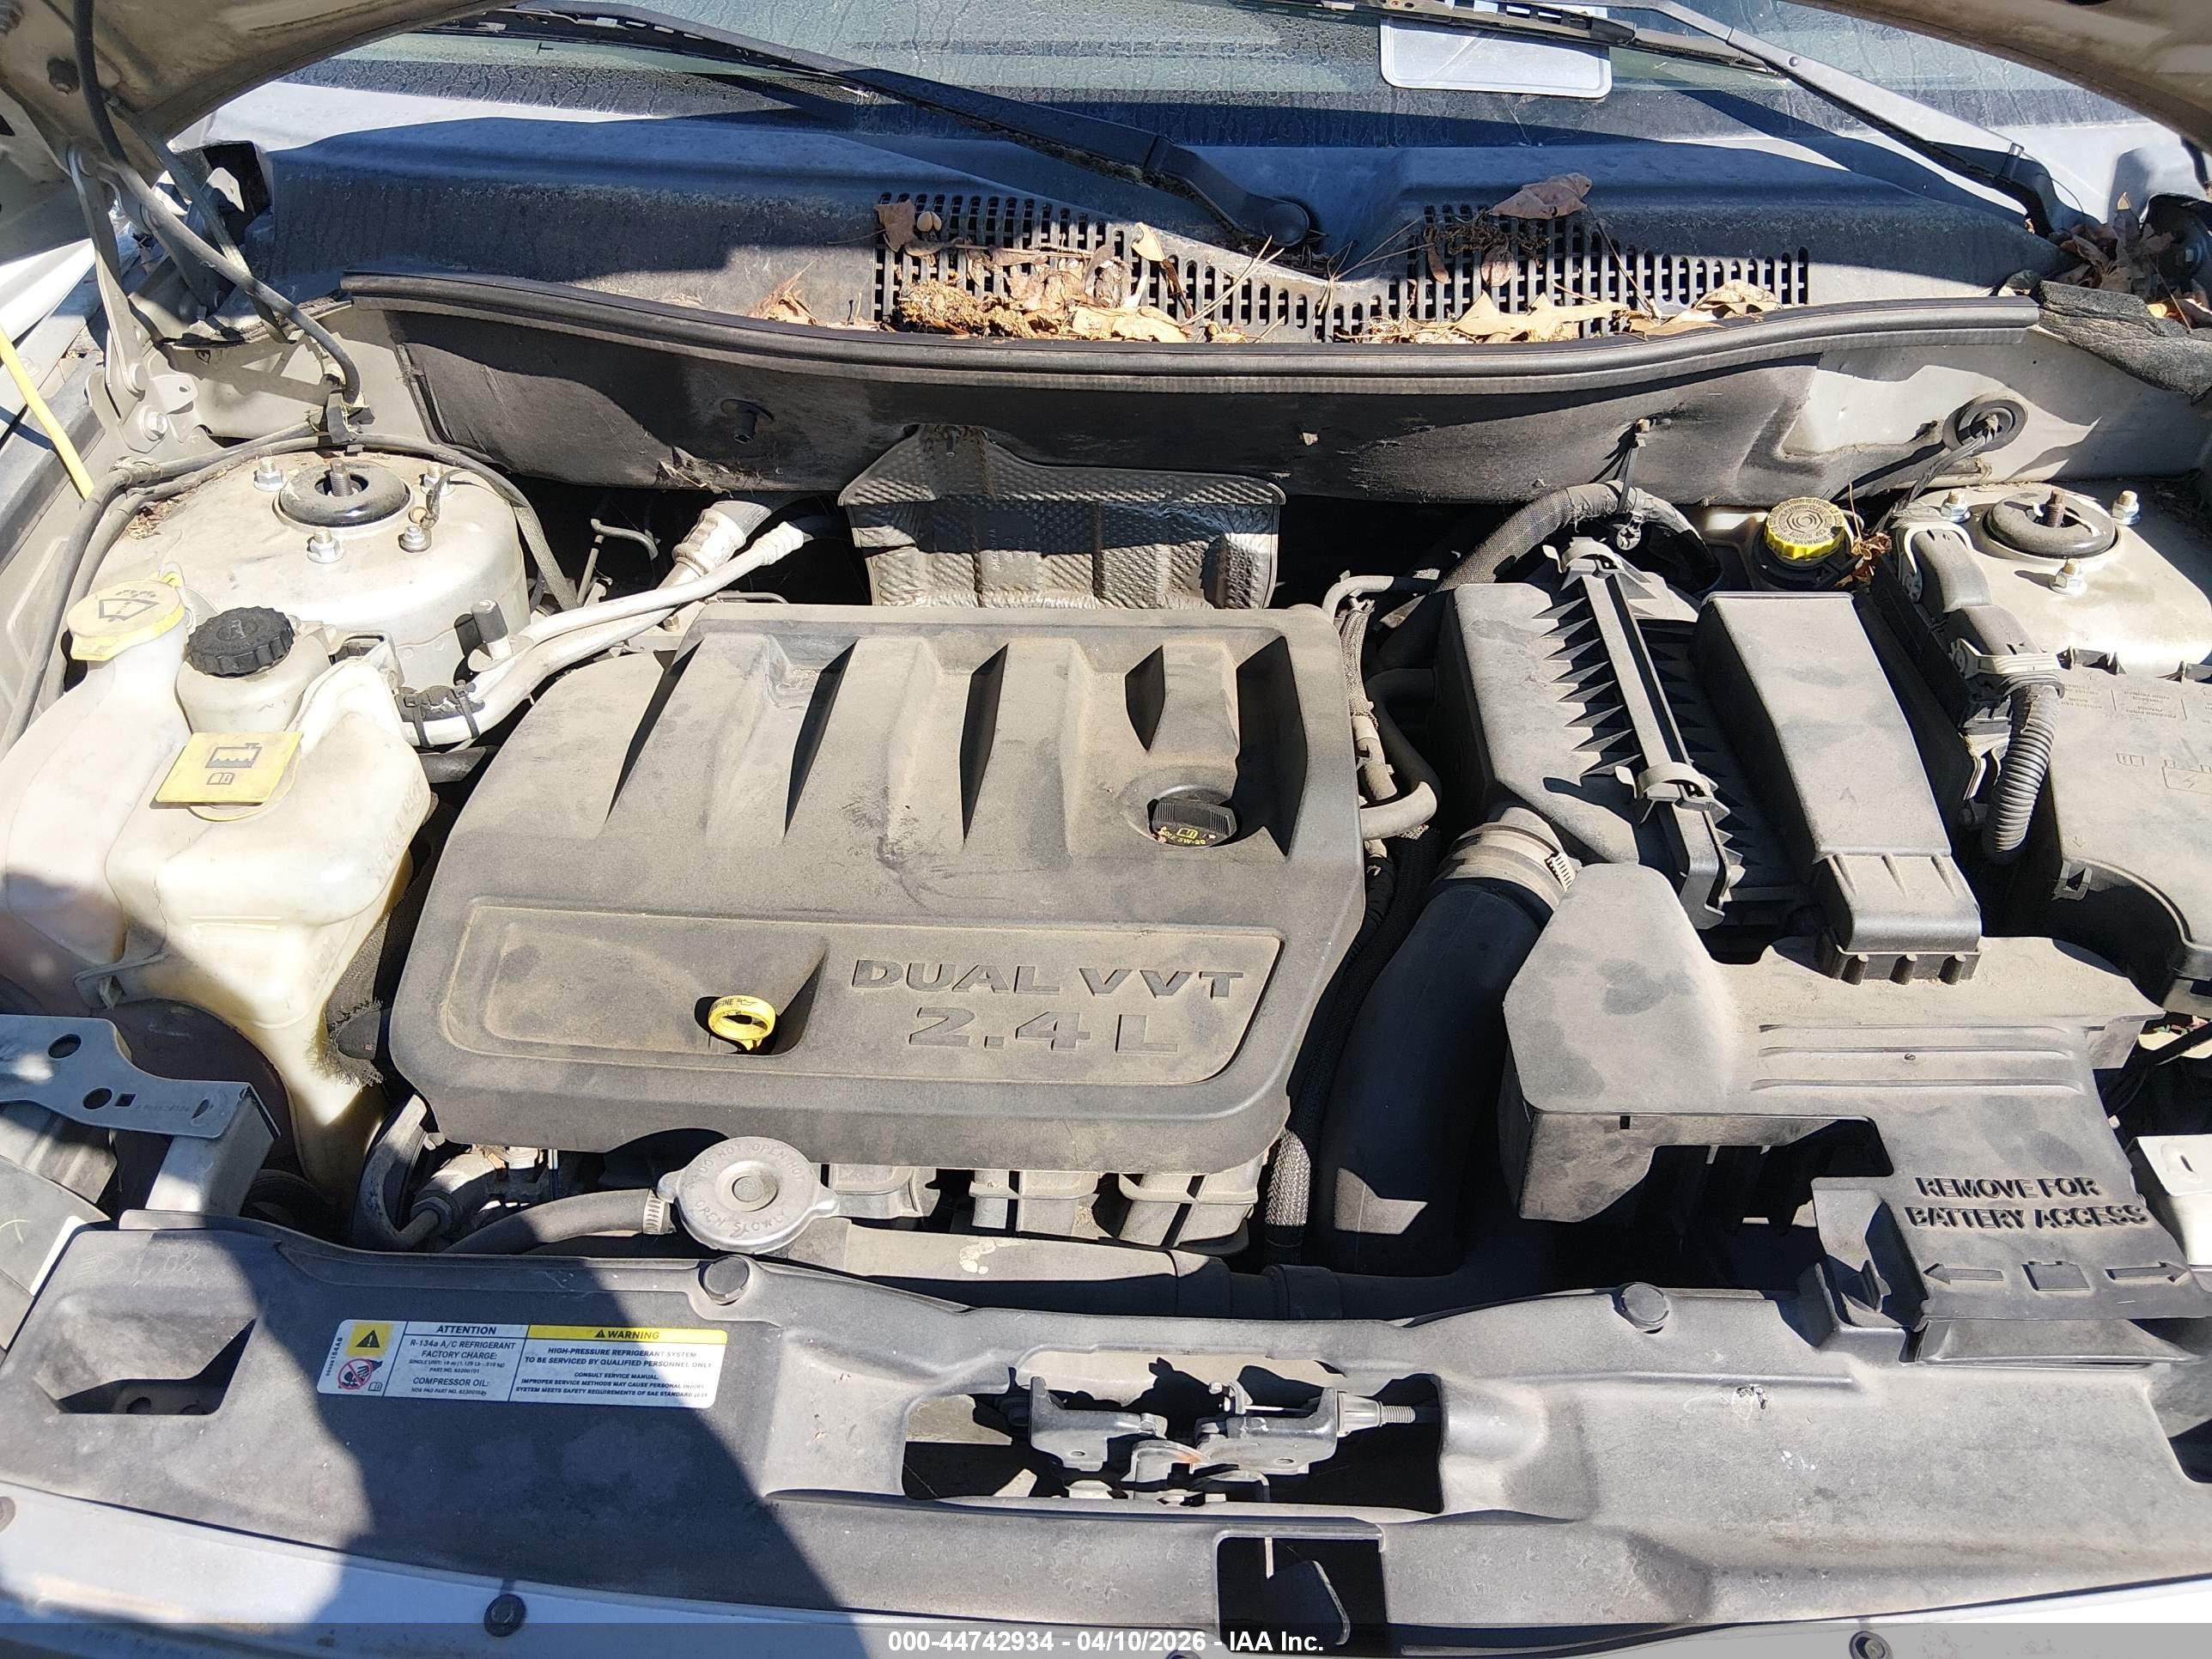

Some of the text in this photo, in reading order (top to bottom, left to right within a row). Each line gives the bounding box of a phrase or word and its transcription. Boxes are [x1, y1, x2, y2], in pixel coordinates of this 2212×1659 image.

[851, 959, 1243, 999] DUAL VVT
[718, 1144, 741, 1158] NOT
[751, 1143, 788, 1160] OPEN
[787, 1160, 805, 1182] HOT
[1915, 1177, 2102, 1199] REMOVE FOR
[696, 1200, 726, 1228] OPEN
[1904, 1205, 2148, 1229] BATTERY ACCESS
[436, 1325, 497, 1334] ATTENTION
[607, 1330, 660, 1340] WARNING
[440, 1340, 459, 1349] A/C
[459, 1341, 516, 1350] REFRIGERANT
[421, 1350, 498, 1360] FACTORY CHARGE:
[548, 1347, 611, 1356] HIGH-PRESSURE
[611, 1349, 665, 1358] REFRIGERANT
[412, 1376, 490, 1388] COMPRESSOR OIL:
